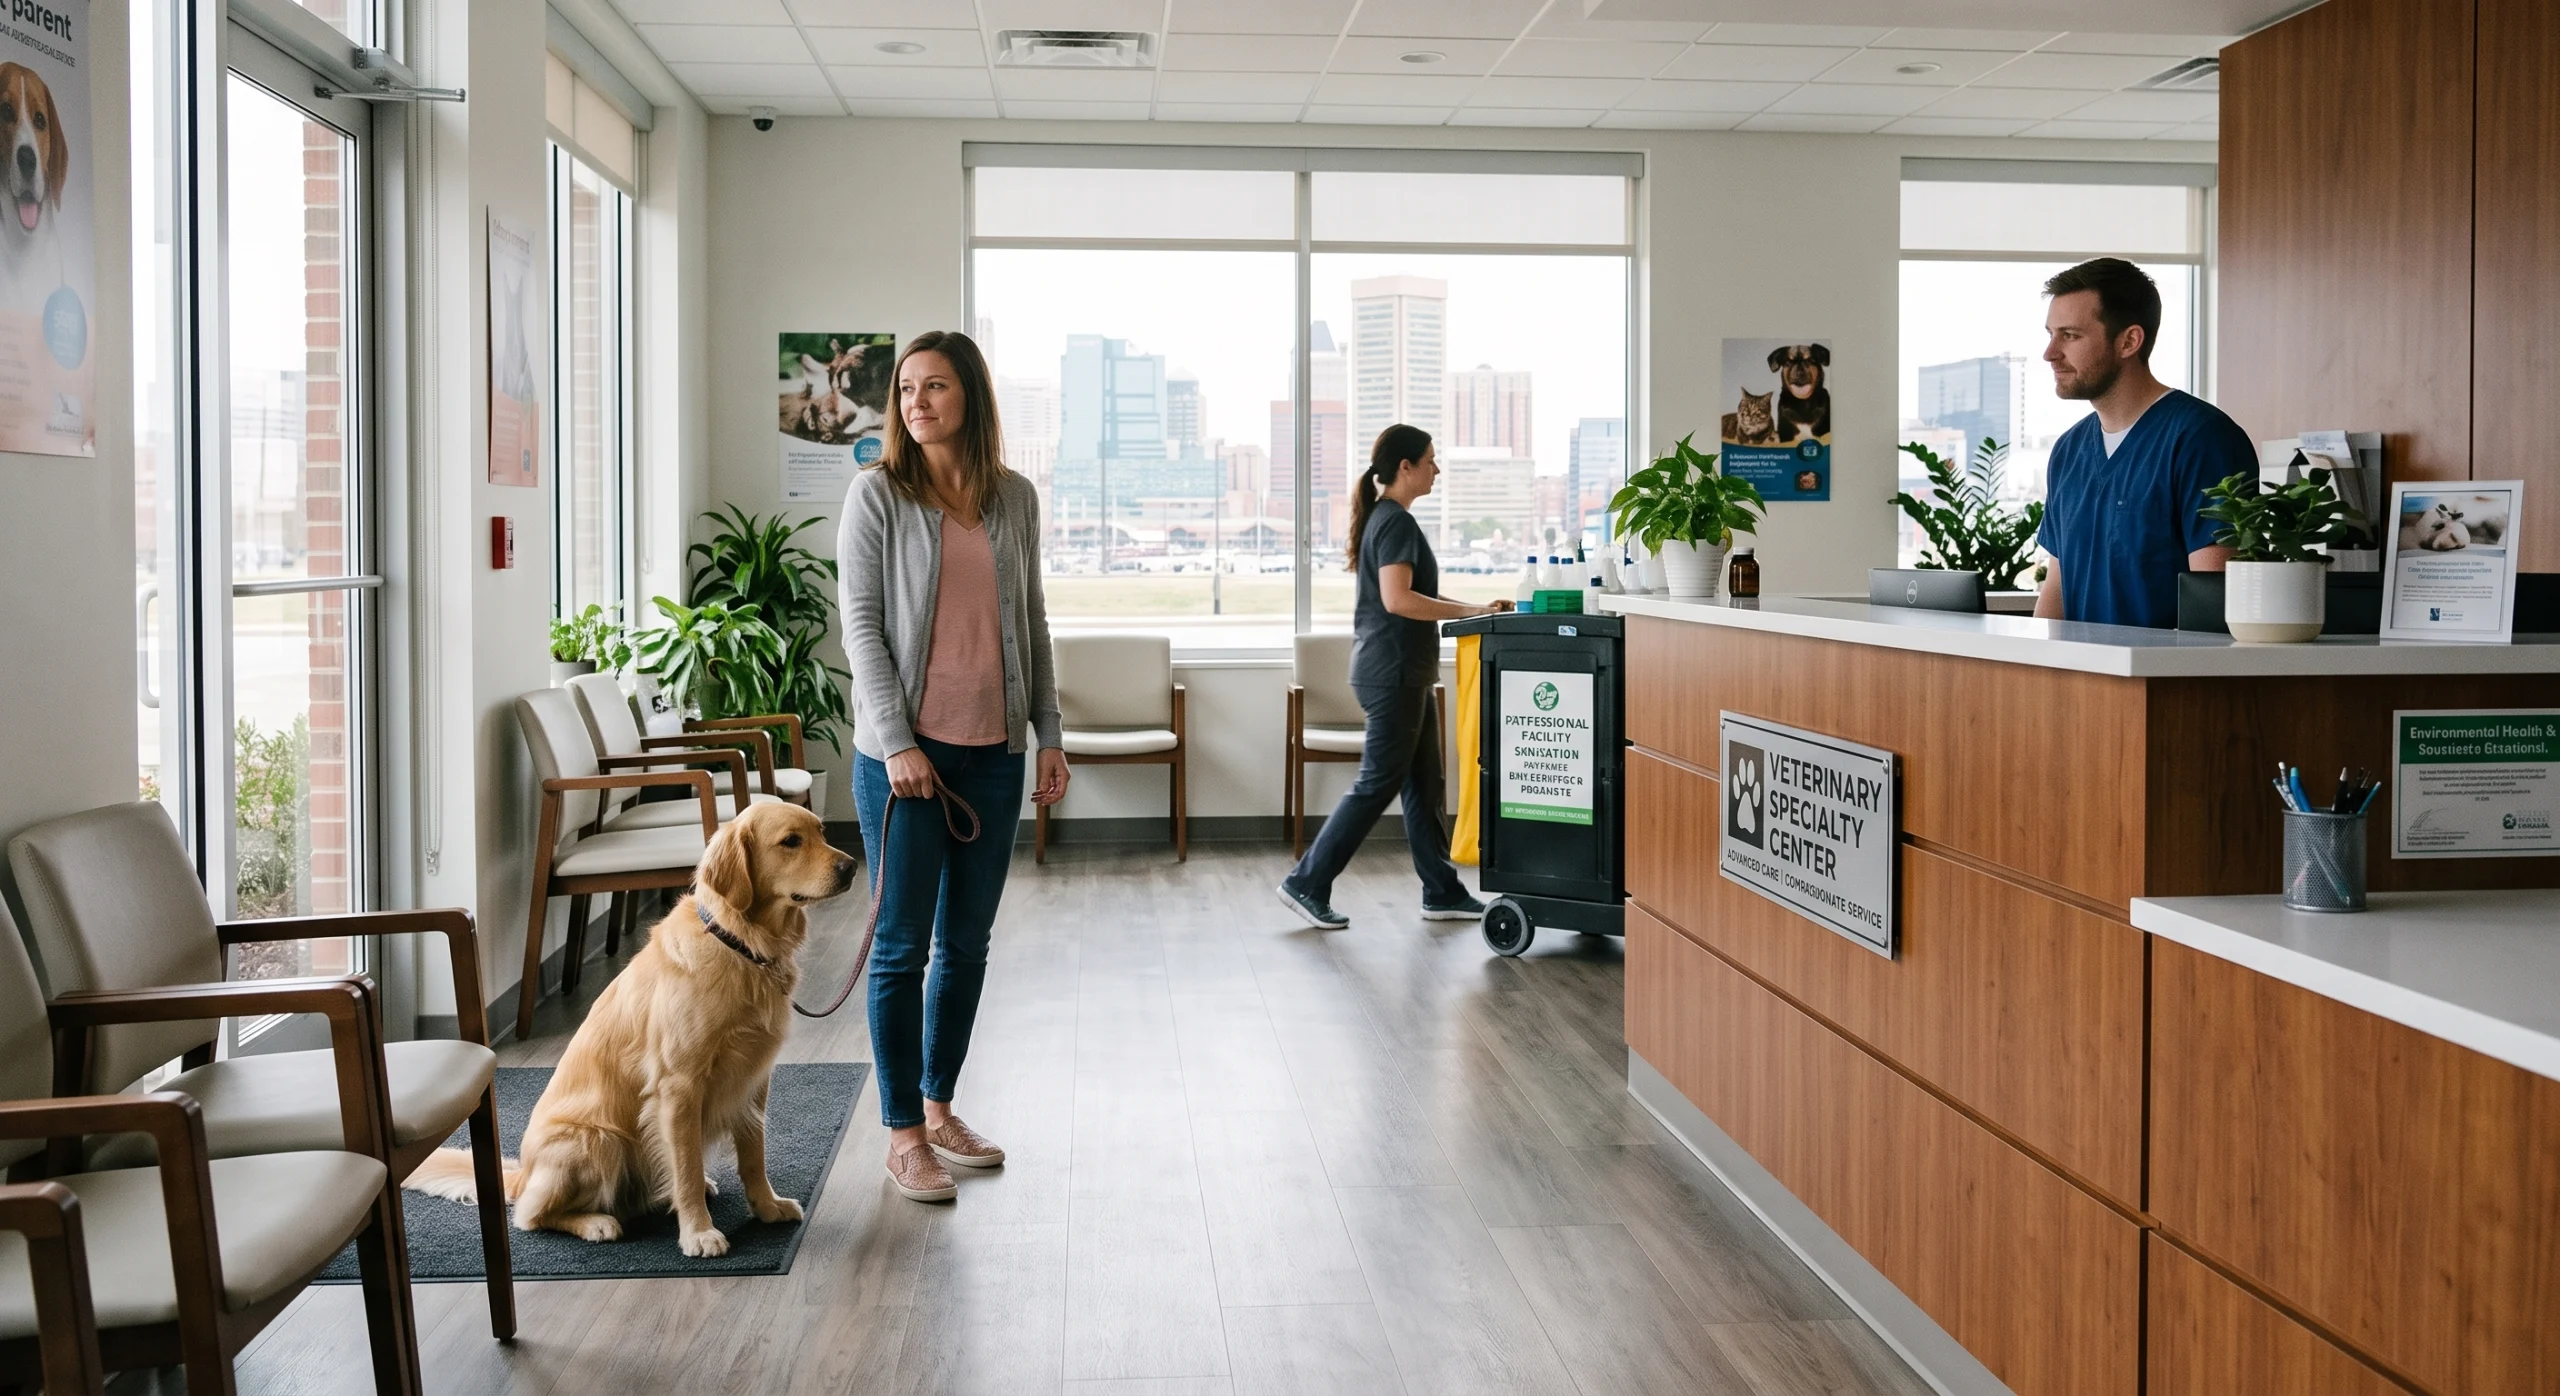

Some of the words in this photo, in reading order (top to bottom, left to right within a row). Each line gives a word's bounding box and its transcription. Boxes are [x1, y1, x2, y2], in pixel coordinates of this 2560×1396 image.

[12, 0, 72, 42] parent
[1521, 731, 1571, 743] FACILITY
[2410, 725, 2500, 739] Environmental
[2502, 724, 2543, 738] Health
[2546, 724, 2557, 737] &
[1769, 752, 1882, 813] VETERINARY
[1769, 790, 1864, 848] SPECIALTY
[1769, 828, 1836, 881] CENTER
[1762, 863, 1779, 882] CARE
[1848, 899, 1882, 929] SERVICE
